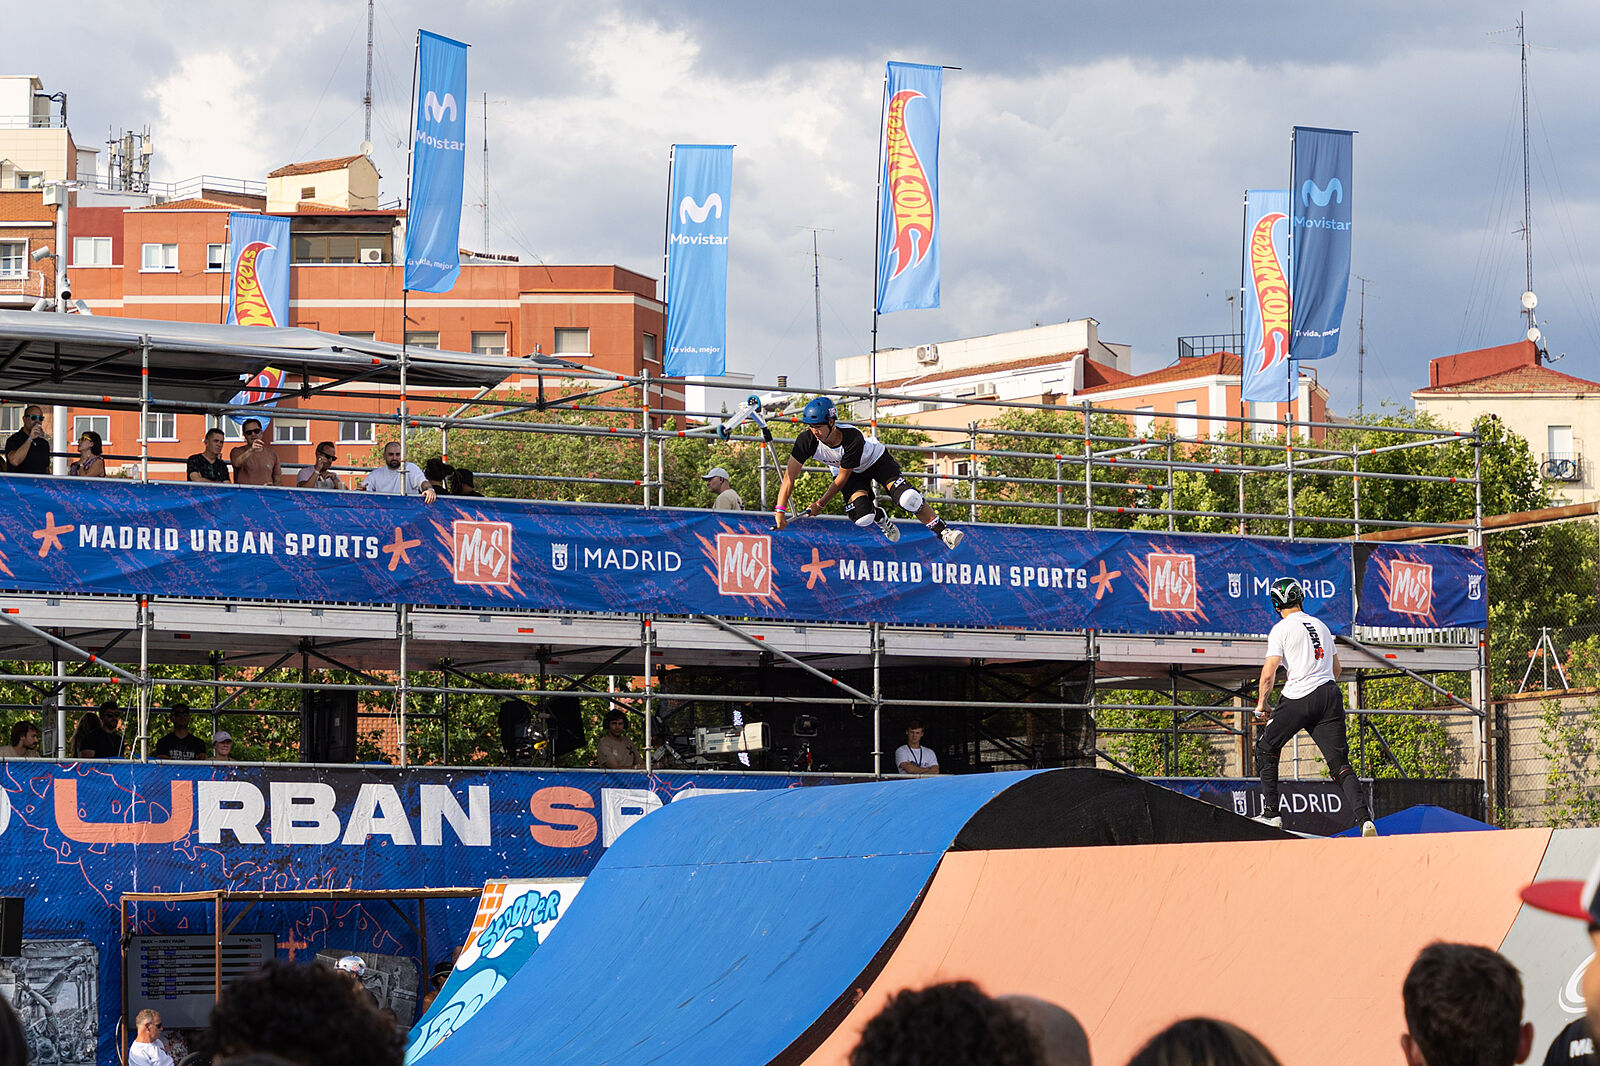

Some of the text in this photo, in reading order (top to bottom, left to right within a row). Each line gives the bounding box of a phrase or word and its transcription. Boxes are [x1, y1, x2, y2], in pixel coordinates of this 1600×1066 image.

[1293, 215, 1352, 230] Movistar
[670, 232, 729, 246] Movistar
[680, 345, 698, 354] vida,
[699, 345, 721, 355] mejor
[79, 523, 379, 559] MADRID URBAN SPORTS
[584, 547, 682, 573] MADRID
[839, 558, 1088, 589] MADRID URBAN SPORTS
[1253, 575, 1336, 599] MRID
[54, 778, 491, 846] URBAN
[1260, 793, 1342, 814] ADRID
